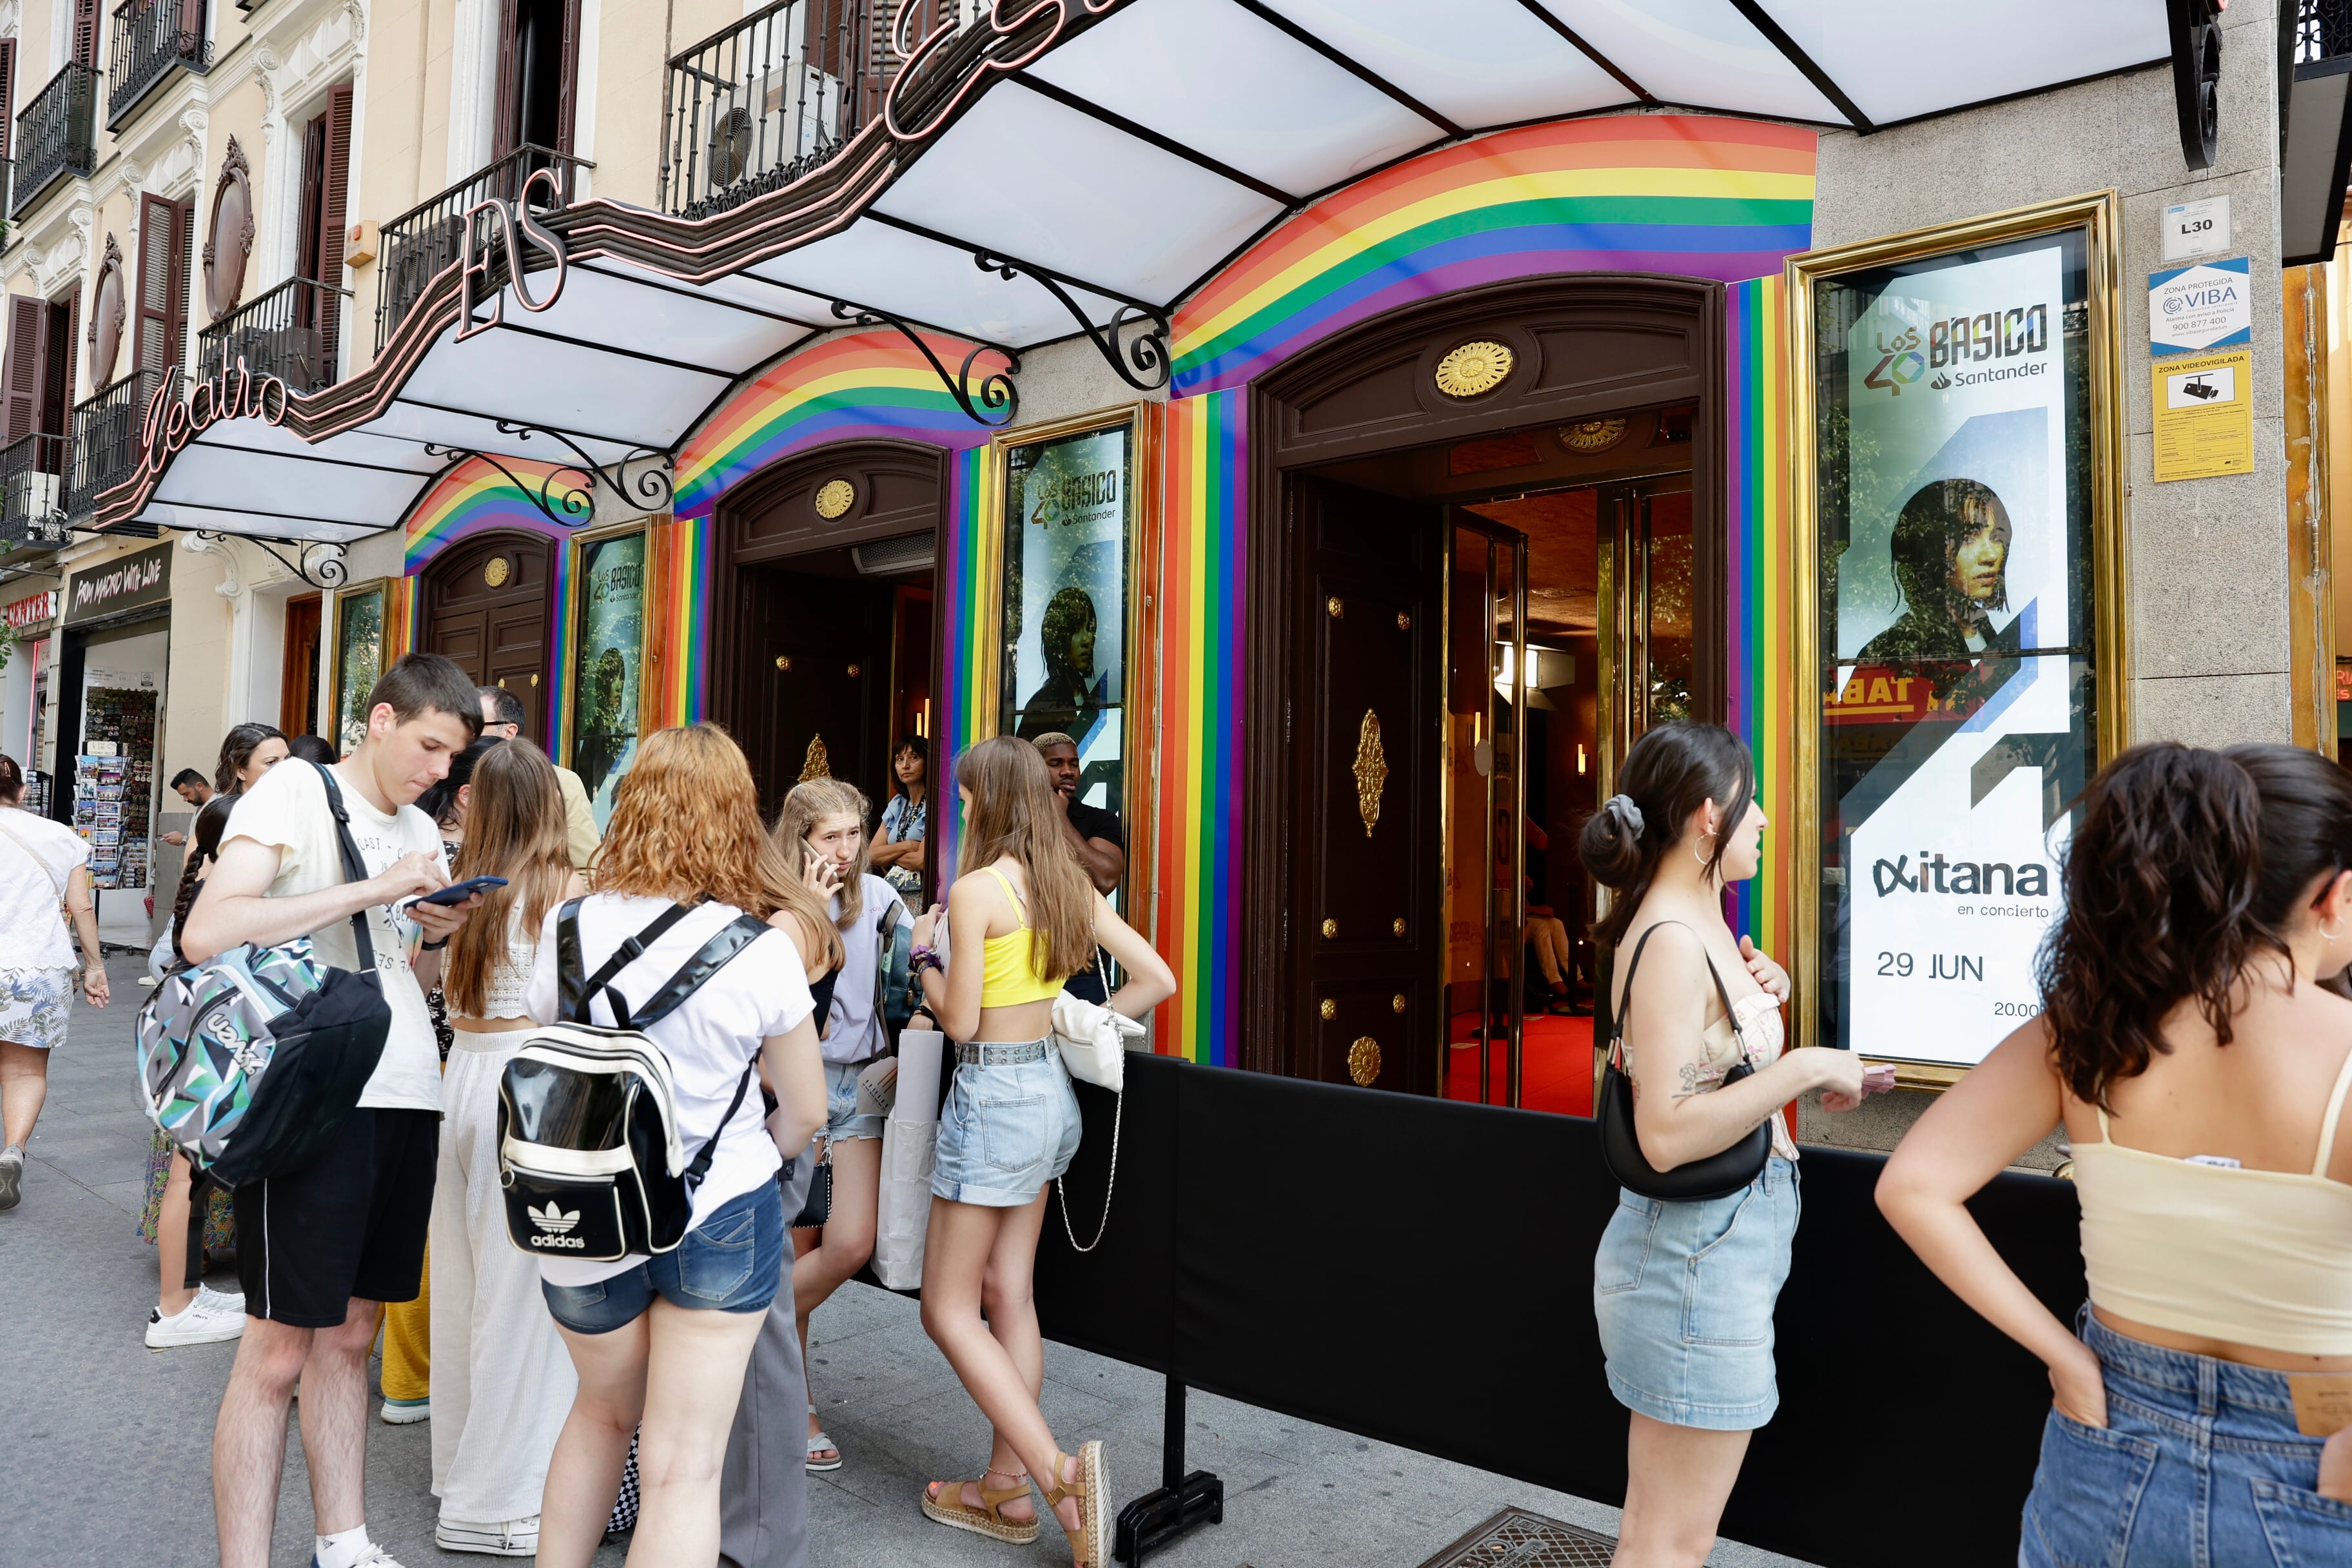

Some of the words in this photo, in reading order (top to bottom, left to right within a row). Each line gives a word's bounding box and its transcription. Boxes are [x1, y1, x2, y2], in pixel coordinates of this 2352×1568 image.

[2182, 219, 2213, 234] L30
[2164, 286, 2186, 295] ZONA
[2188, 277, 2233, 289] PROTEGIDA
[2185, 286, 2237, 308] VIBA
[2171, 325, 2228, 338] www.vibaseguridad.es
[2173, 323, 2189, 331] 900
[2191, 319, 2207, 328] 877
[2210, 316, 2226, 325] 400
[2159, 365, 2180, 373] ZONA
[2182, 355, 2244, 369] VIDEOVIGILADA
[1955, 362, 2047, 387] Santander
[143, 335, 288, 473] Teatro
[1073, 509, 1116, 524] Santander
[74, 580, 94, 612] FROM
[93, 571, 122, 605] MADRID
[7, 591, 49, 627] CENTER
[1957, 905, 1974, 916] en
[1980, 905, 2048, 917] concierto
[1877, 952, 1914, 977] 29
[1928, 954, 1983, 981] JUN
[531, 1234, 585, 1249] adidas
